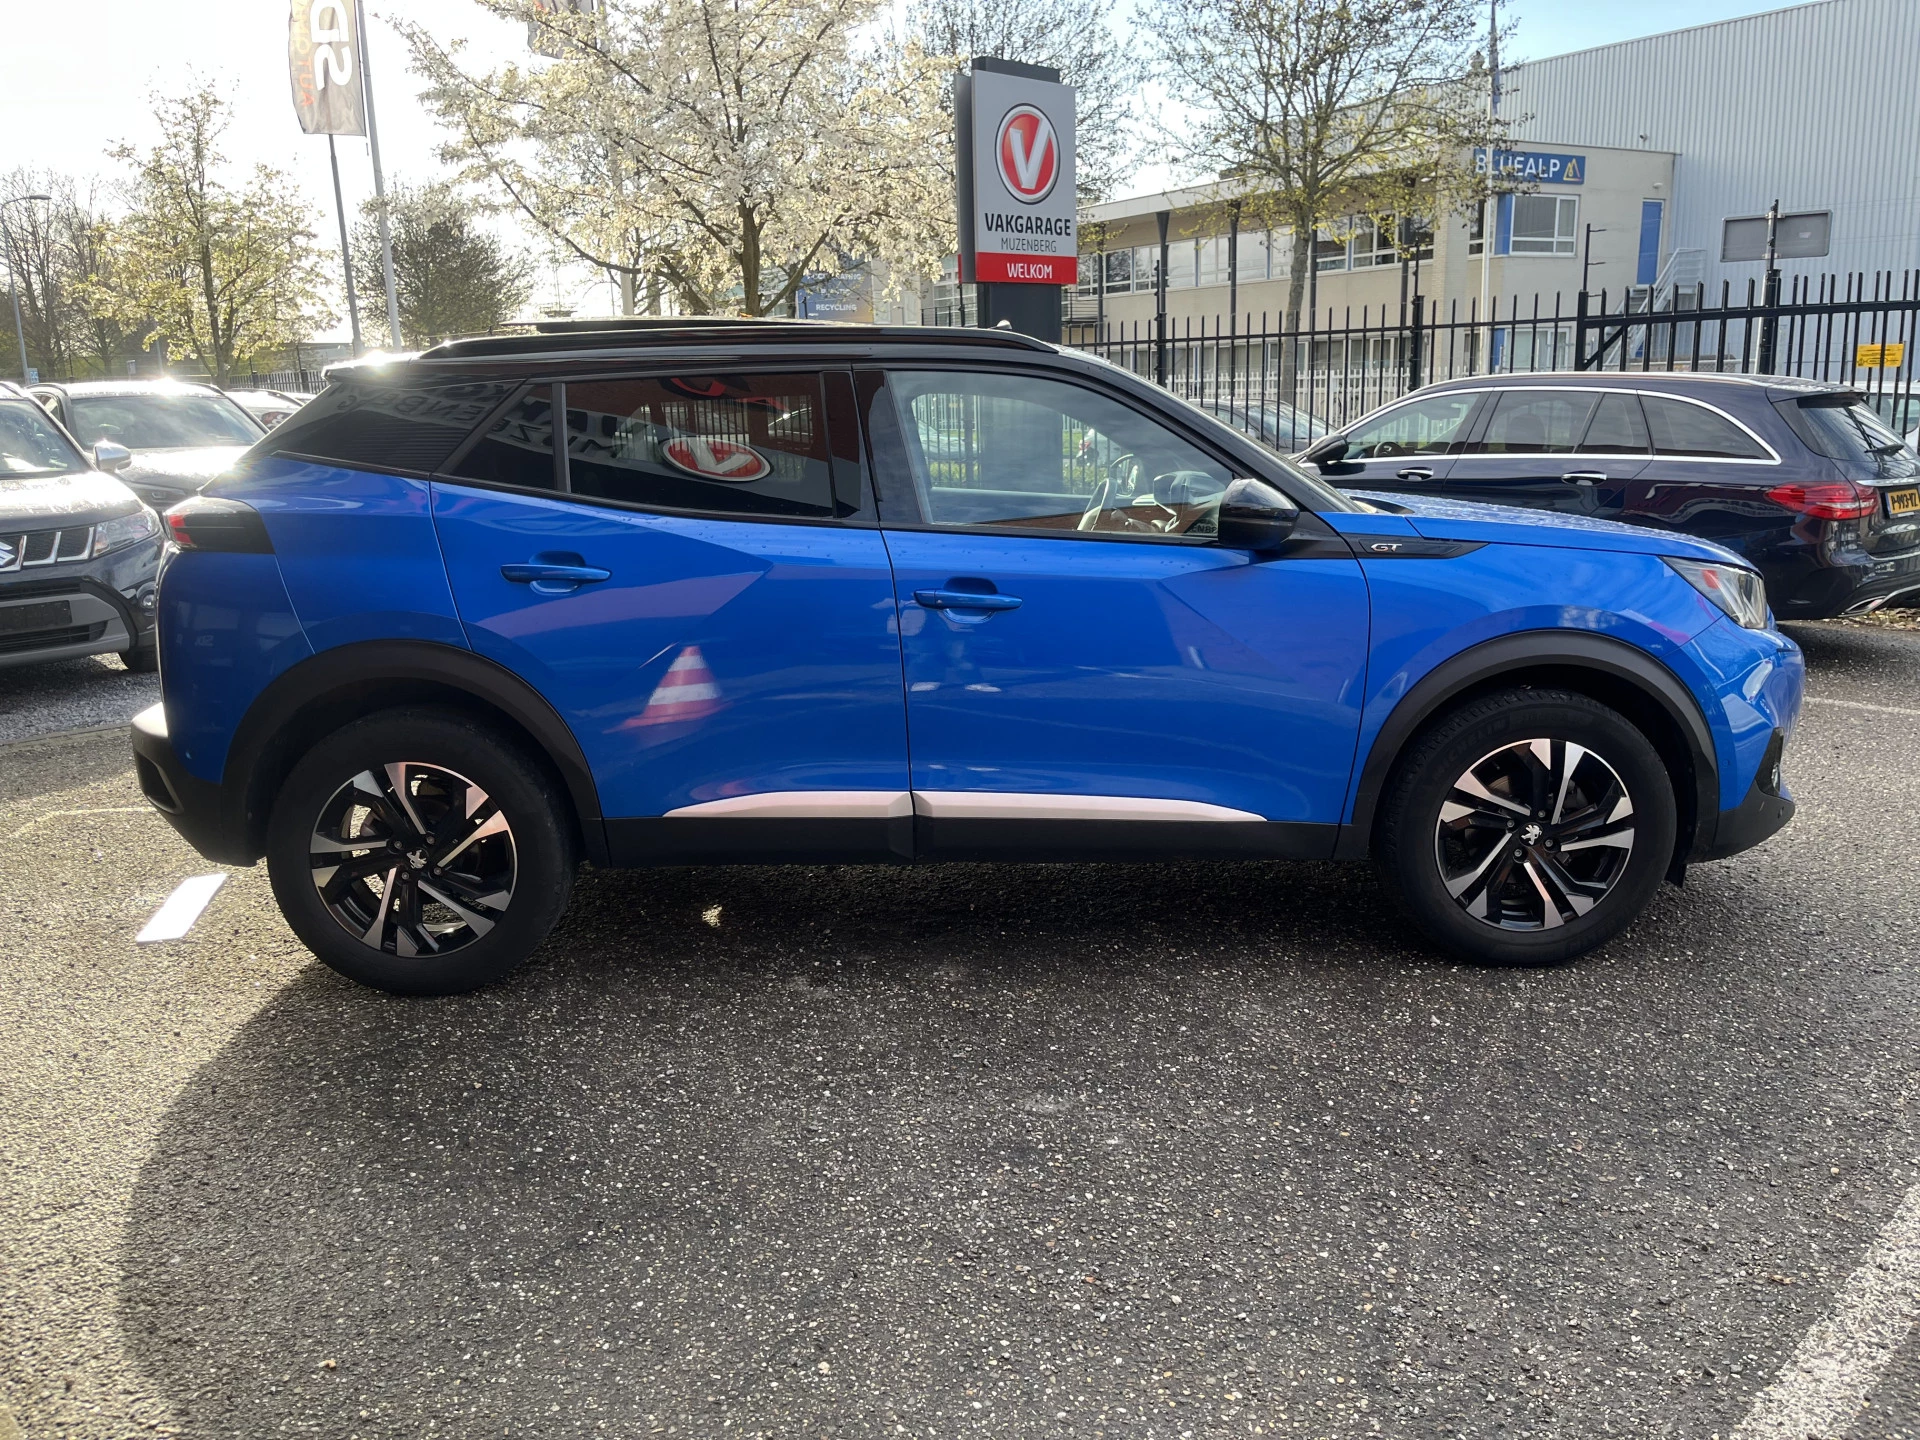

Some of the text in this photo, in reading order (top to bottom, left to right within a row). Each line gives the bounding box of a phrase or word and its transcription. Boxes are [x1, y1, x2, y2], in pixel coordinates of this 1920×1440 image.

[984, 212, 1072, 237] VAKGARAGE
[1001, 237, 1057, 253] MUZENBERG
[1007, 262, 1053, 280] WELKOM
[815, 303, 858, 312] RECYCLING
[1370, 543, 1403, 552] GT
